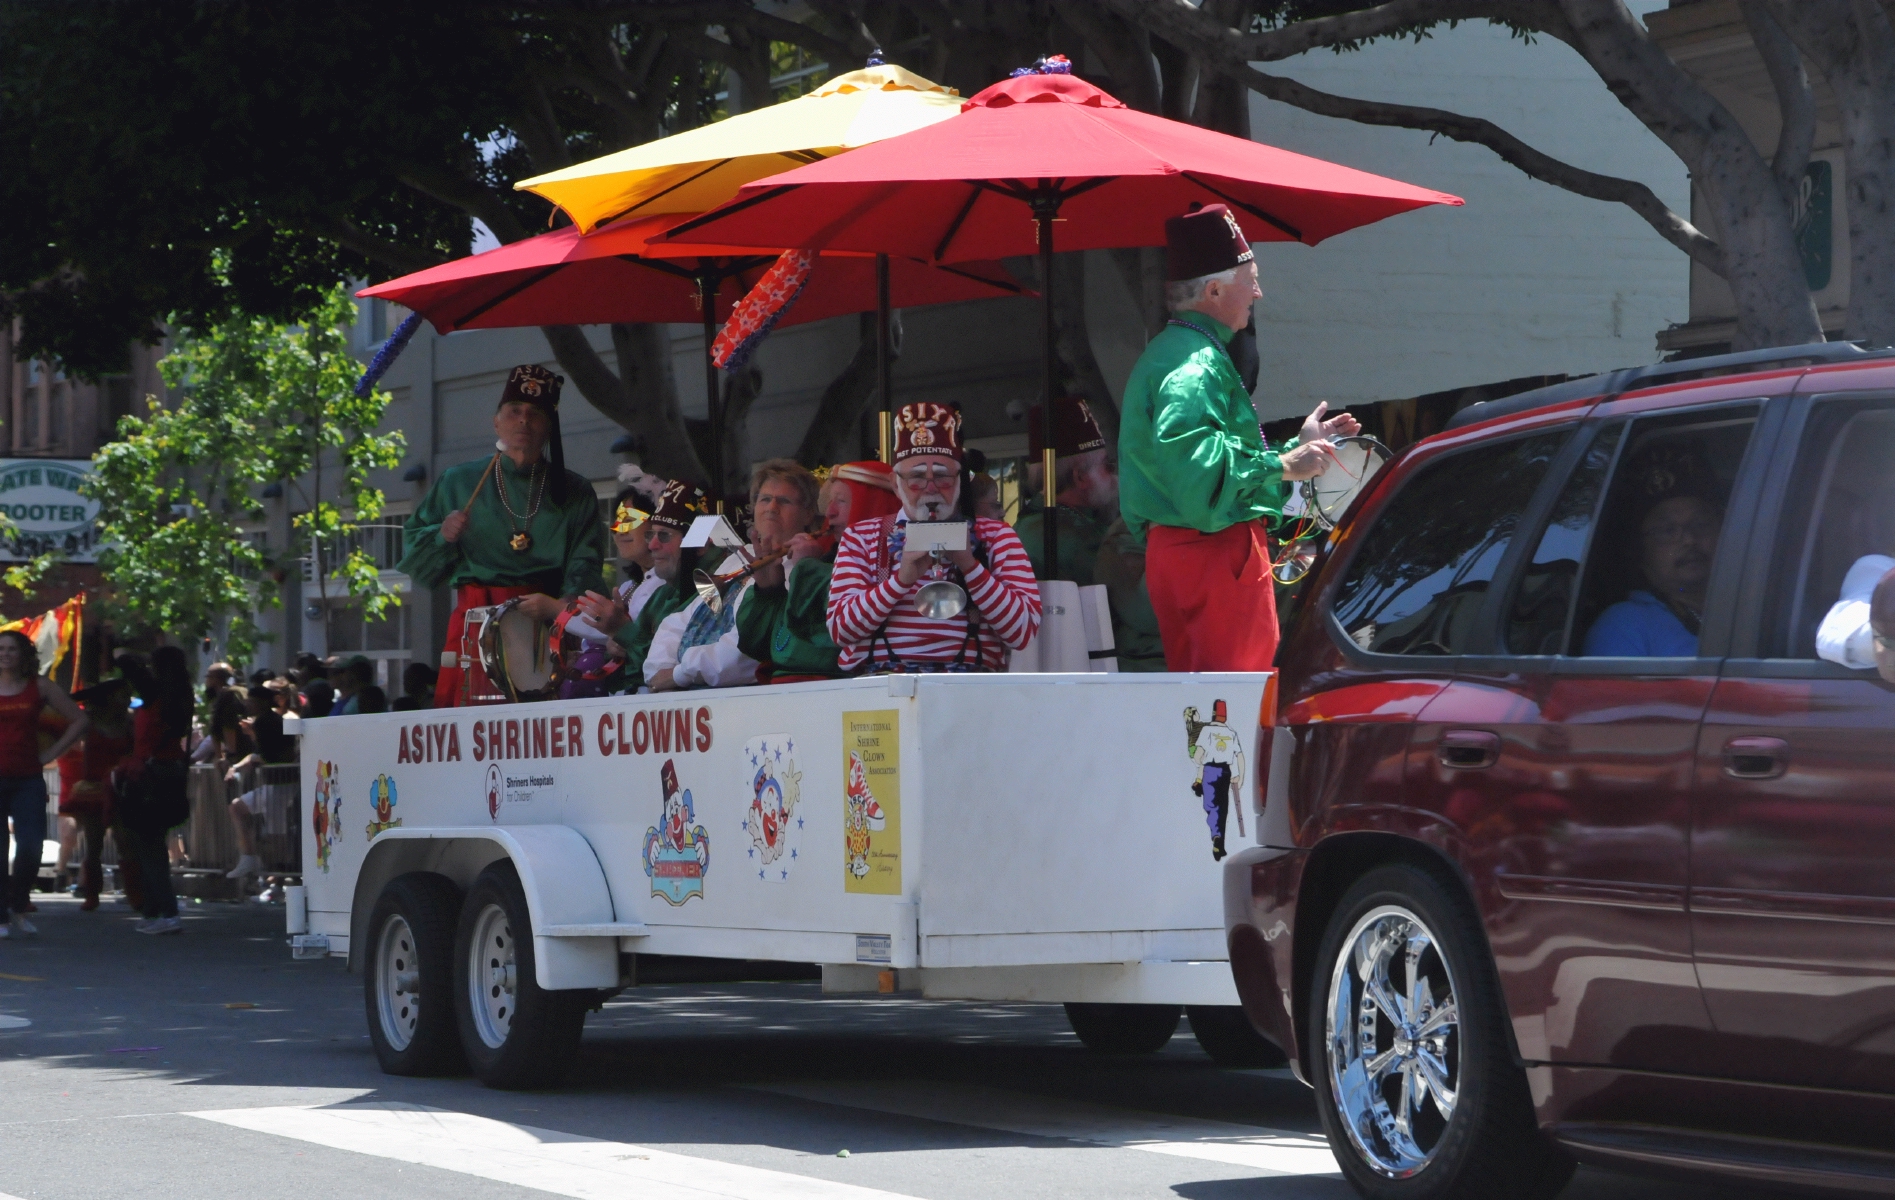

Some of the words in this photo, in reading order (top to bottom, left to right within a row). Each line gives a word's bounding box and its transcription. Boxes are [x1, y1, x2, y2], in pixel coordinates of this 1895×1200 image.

[894, 402, 957, 452] ASIYA
[398, 722, 462, 764] ASIYA
[473, 715, 585, 762] SHRINER
[597, 705, 713, 756] CLOWNS
[506, 776, 529, 788] Shriners
[529, 774, 554, 788] Hospitals
